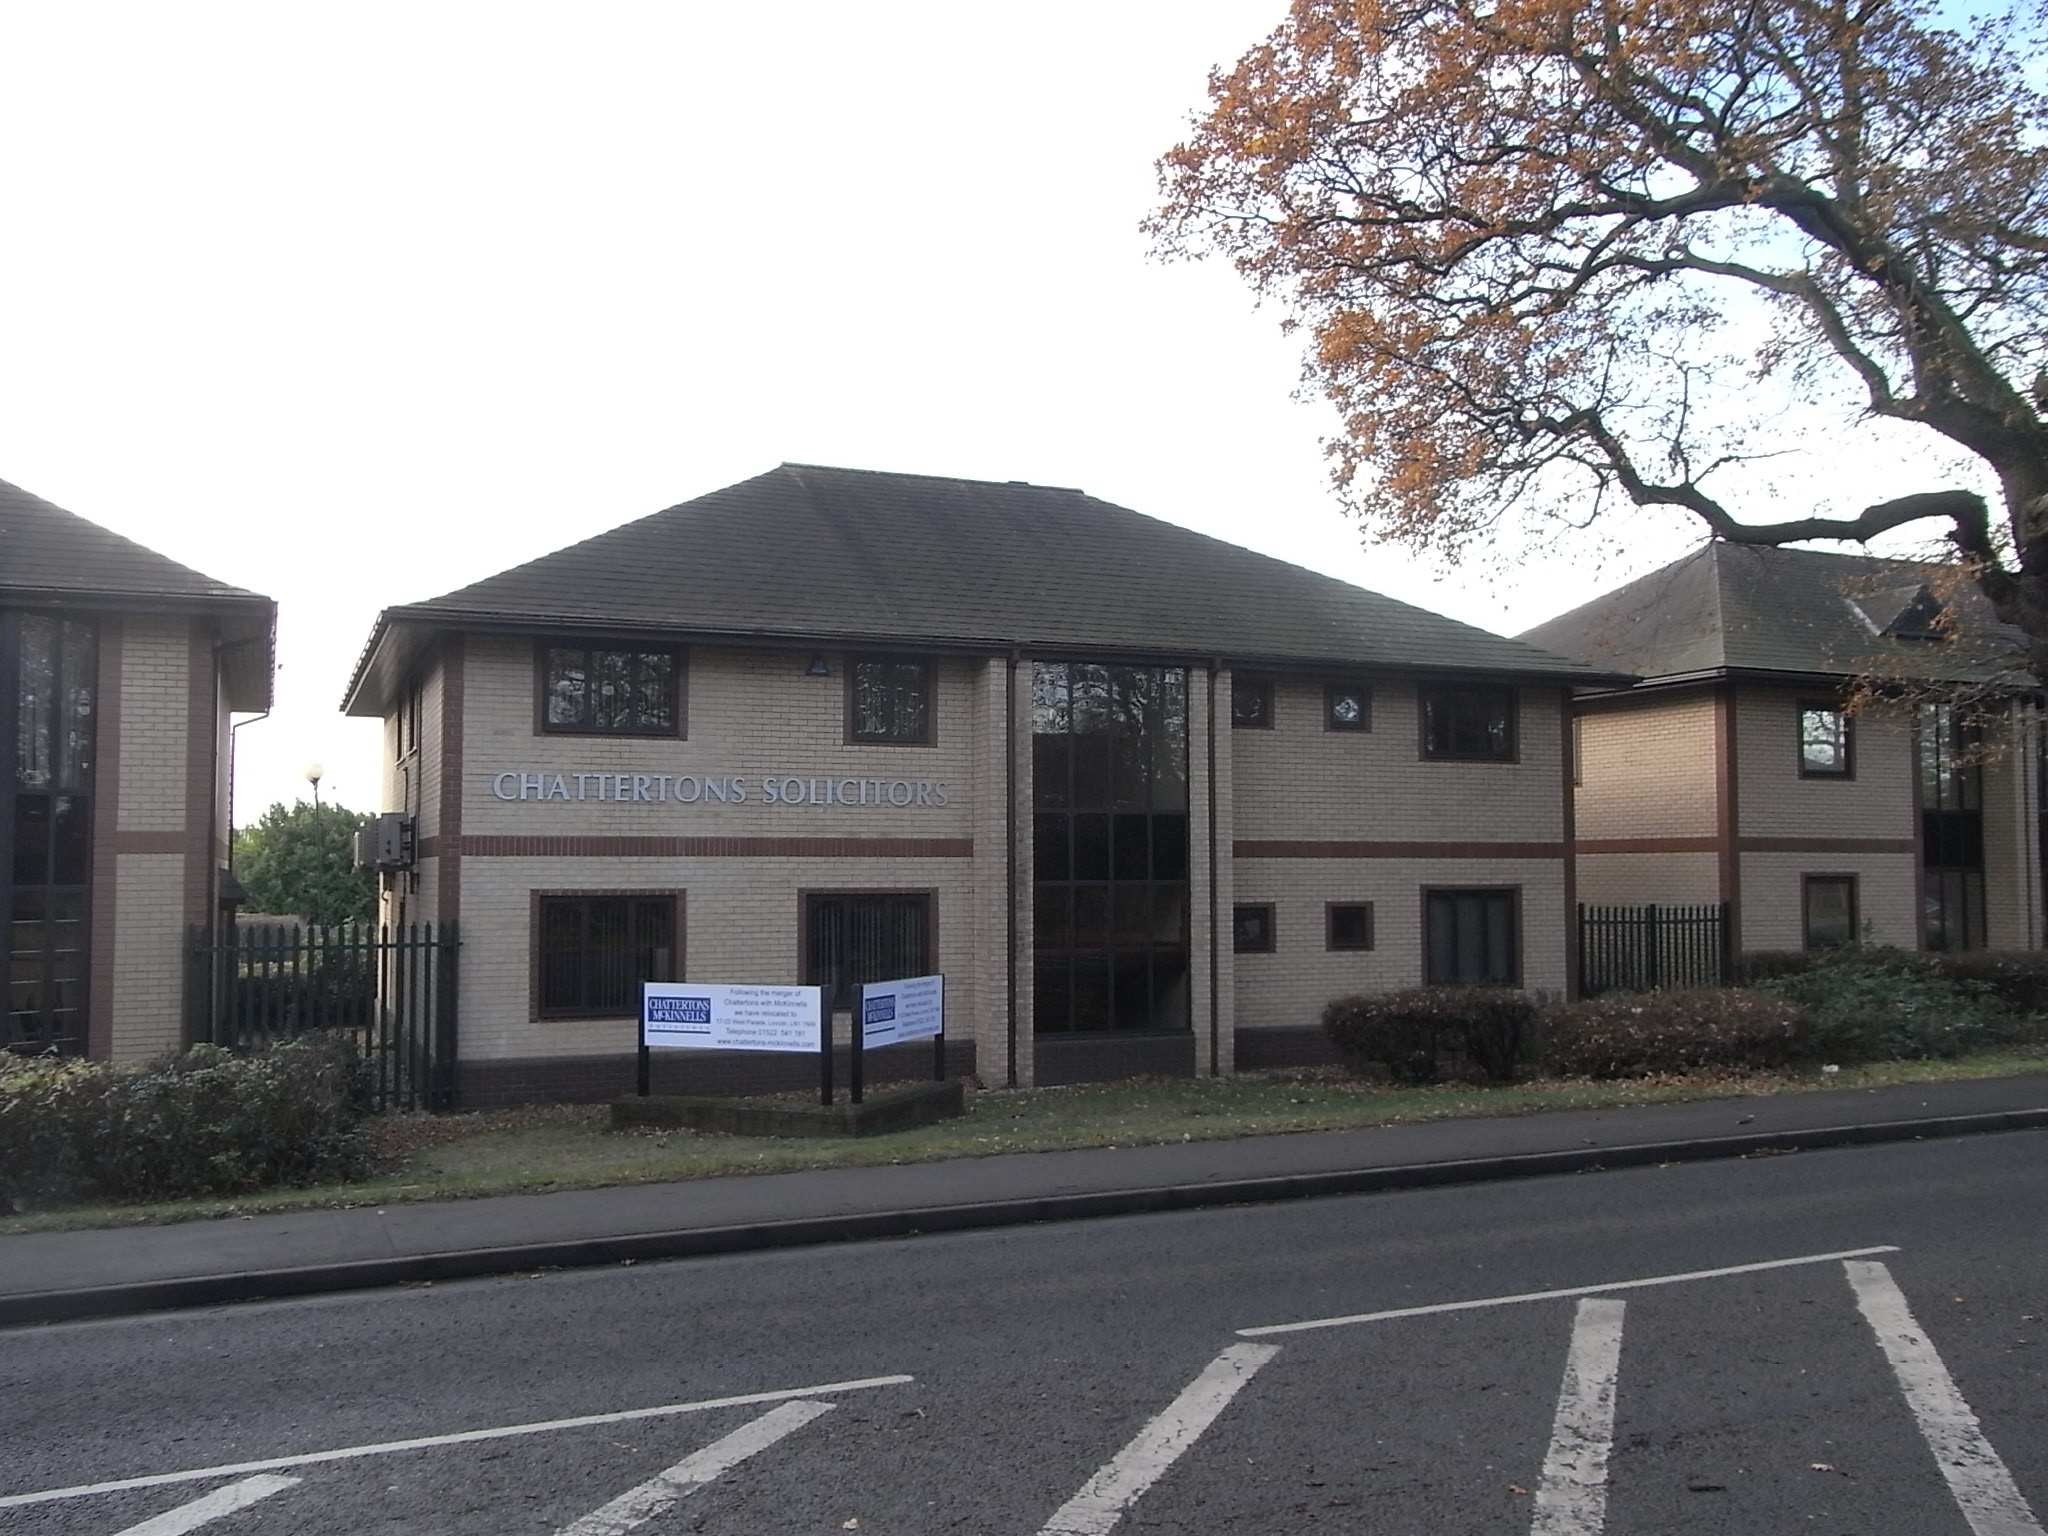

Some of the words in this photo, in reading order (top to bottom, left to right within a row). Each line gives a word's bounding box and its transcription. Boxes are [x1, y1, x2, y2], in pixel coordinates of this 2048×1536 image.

[493, 772, 746, 804] CHATTERTONS
[762, 777, 949, 808] SOLICITORS
[649, 998, 710, 1011] CHATTERTONS
